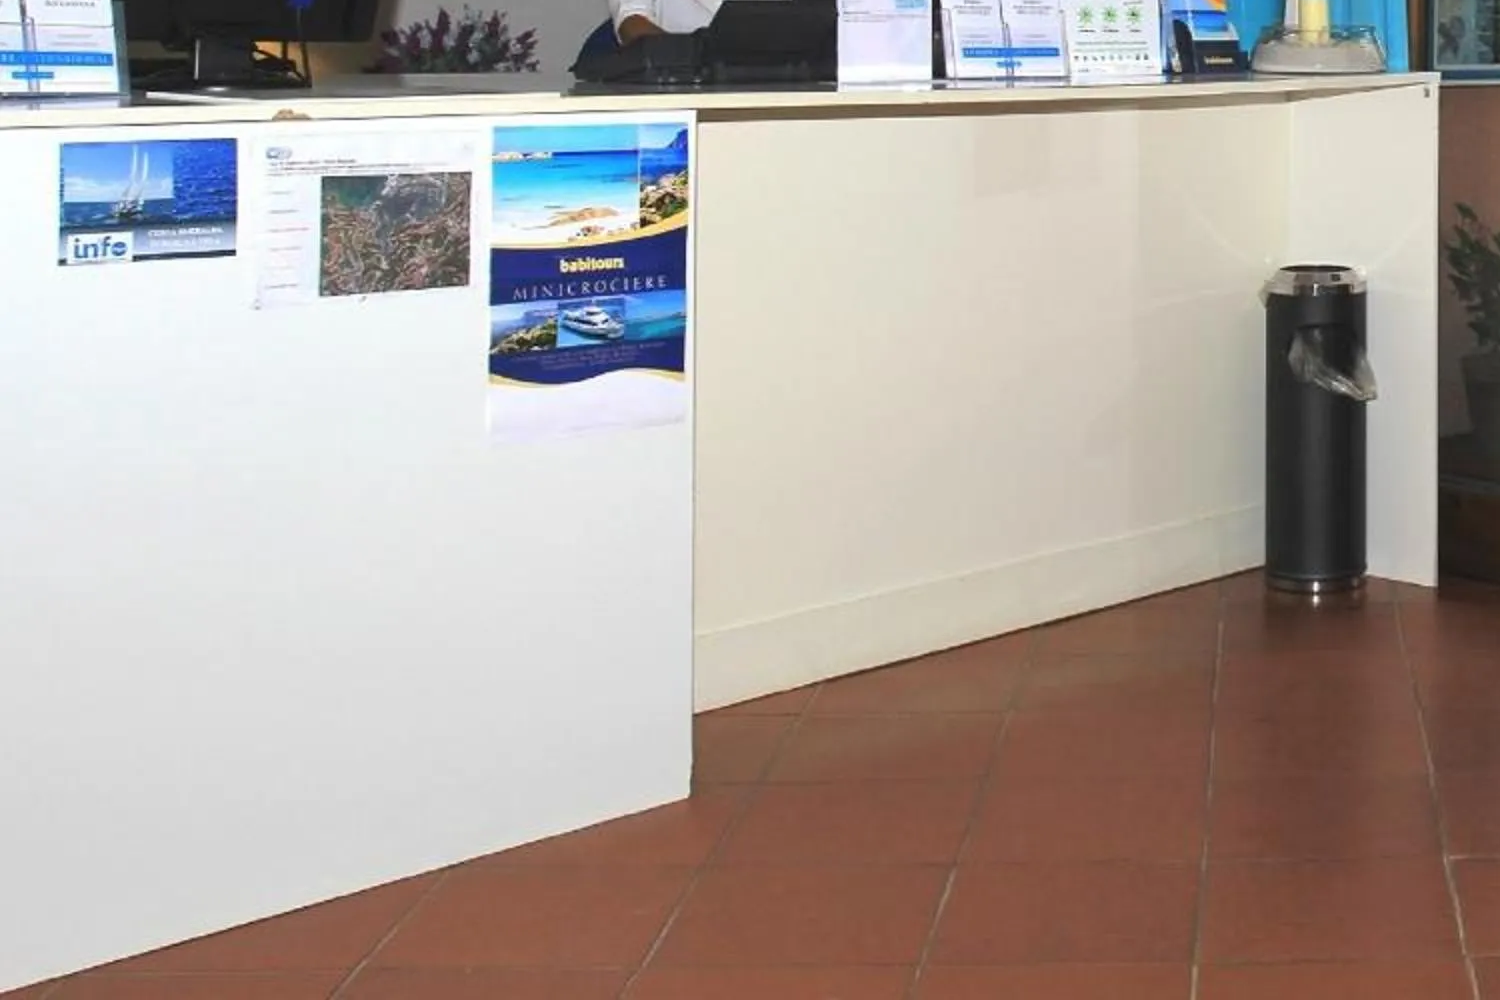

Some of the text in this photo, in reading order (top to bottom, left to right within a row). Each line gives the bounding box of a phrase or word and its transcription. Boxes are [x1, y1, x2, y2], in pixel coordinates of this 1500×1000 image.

[74, 236, 128, 259] info
[560, 256, 625, 273] babitours
[512, 274, 669, 301] MINICROCIERE
